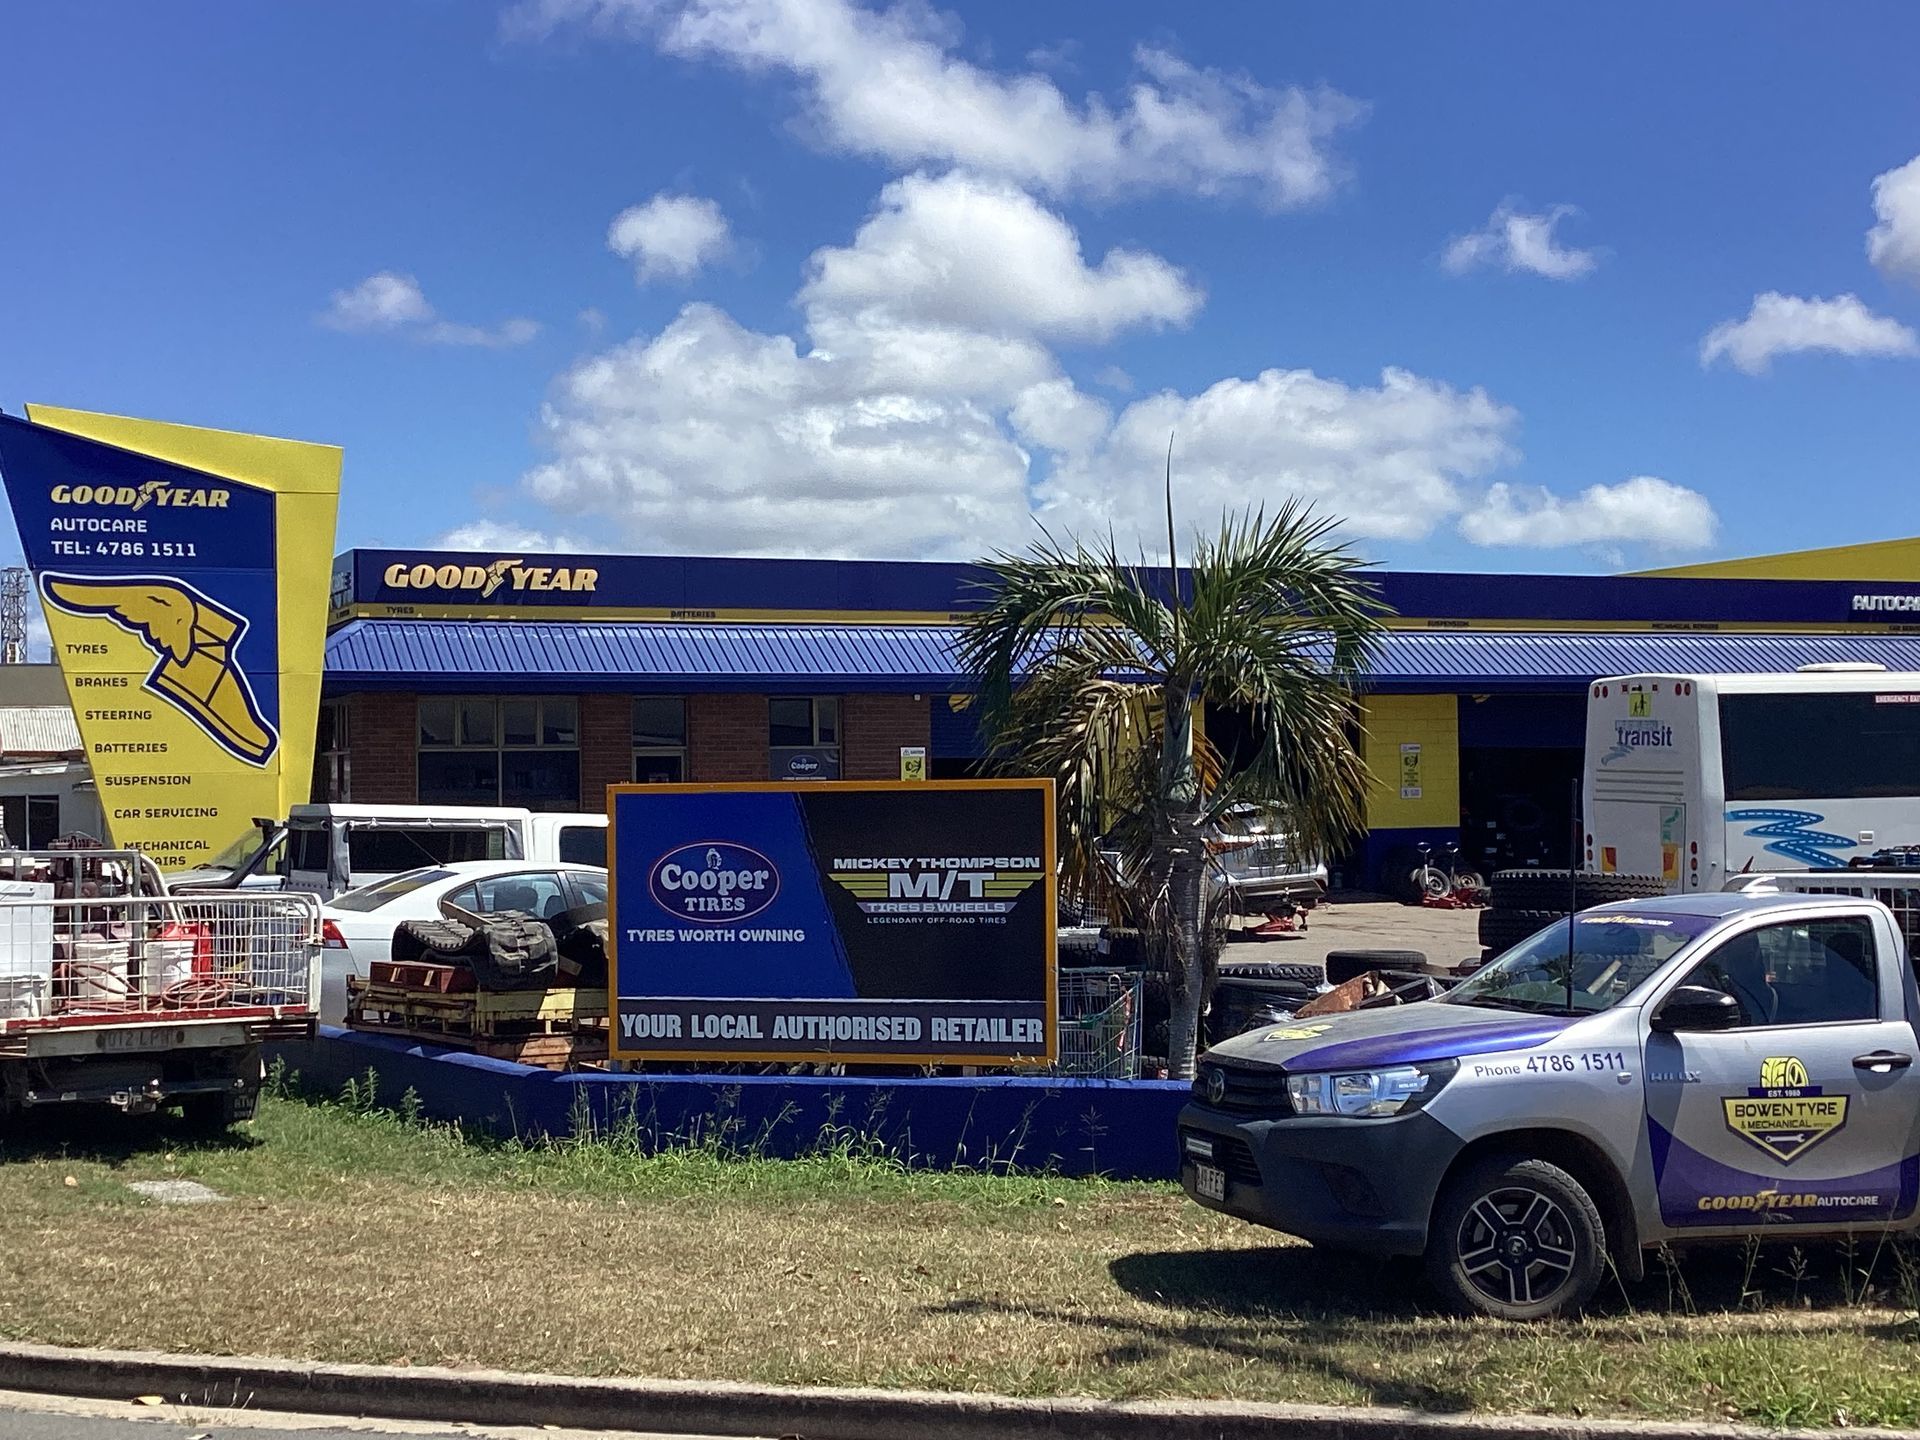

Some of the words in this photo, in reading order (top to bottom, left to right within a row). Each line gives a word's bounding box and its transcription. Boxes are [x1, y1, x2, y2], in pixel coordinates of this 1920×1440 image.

[51, 485, 231, 508] GOODYEAR
[51, 518, 148, 533] AUTOCARE
[51, 541, 91, 555] TEL:
[96, 542, 144, 556] 4786
[151, 543, 197, 557] 1511
[384, 564, 598, 592] GOODYEAR
[385, 606, 415, 614] TYRES
[65, 644, 109, 655] TYRES
[75, 677, 128, 688] BRAKES
[85, 710, 152, 721] STEERING
[1617, 725, 1673, 747] transit
[94, 743, 168, 754] BATTERIES
[790, 761, 818, 771] Cooper
[105, 775, 191, 786] SUSPENSION
[114, 809, 141, 819] CAR
[144, 807, 218, 819] SERVICING
[124, 841, 211, 851] MECHANICAL
[149, 856, 186, 866] AIRS
[833, 858, 914, 869] MICKEY
[916, 857, 1040, 869] THOMPSON
[660, 863, 769, 896] Cooper
[889, 870, 995, 900] M/T
[684, 897, 746, 911] TIRES
[867, 903, 920, 913] TIRES
[939, 903, 1006, 913] WHEELS
[627, 929, 675, 942] TYRES
[677, 929, 735, 942] WORTH
[738, 929, 806, 942] OWNING
[620, 1014, 682, 1038] YOUR
[691, 1014, 763, 1039] LOCAL
[772, 1015, 921, 1042] AUTHORISED
[931, 1017, 1043, 1043] RETAILER
[1474, 1065, 1521, 1077] Phone
[1526, 1055, 1575, 1073] 4786
[1581, 1052, 1625, 1071] 1511
[1767, 1090, 1784, 1098] EST.
[1734, 1104, 1793, 1117] BOWEN
[1796, 1102, 1837, 1116] TYRE
[1747, 1119, 1811, 1129] MECHANICAL
[1698, 1194, 1817, 1210] GOODYEAR
[1817, 1196, 1878, 1207] AUTOCARE
